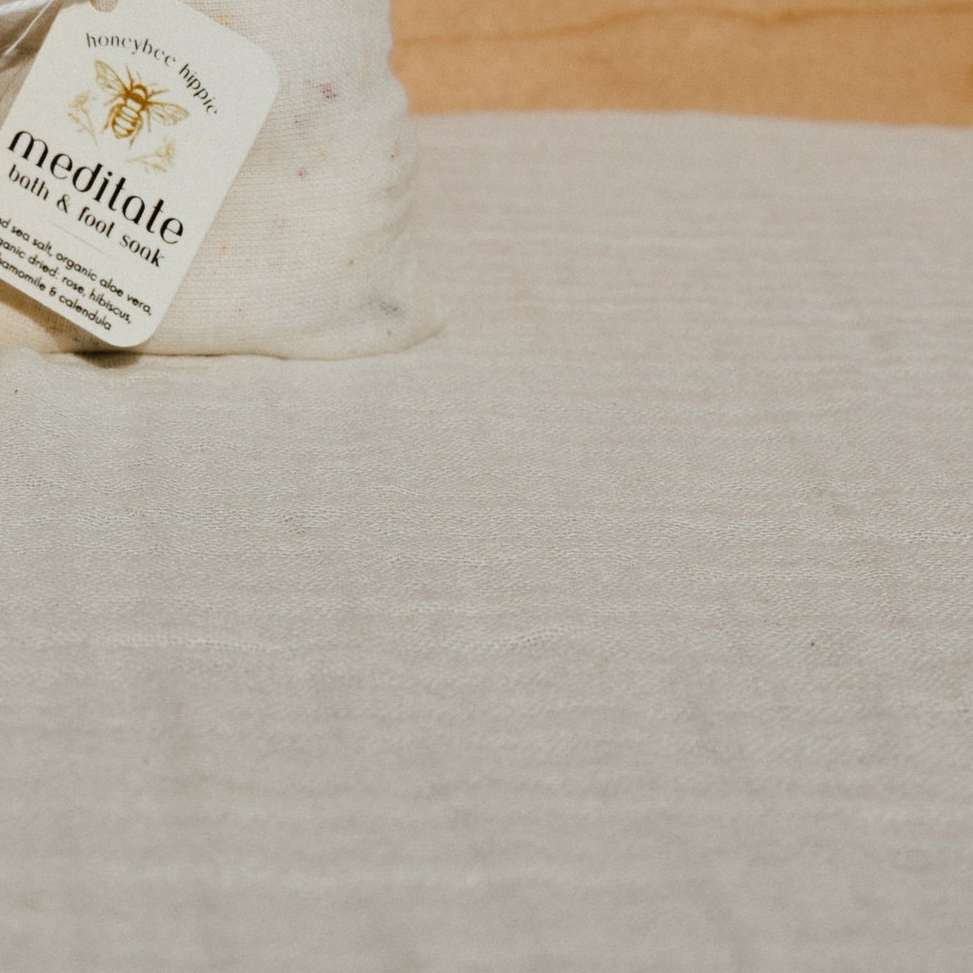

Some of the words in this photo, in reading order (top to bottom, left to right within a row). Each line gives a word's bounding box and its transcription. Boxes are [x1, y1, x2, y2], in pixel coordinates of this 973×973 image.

[86, 32, 176, 67] honeybee
[178, 63, 218, 115] hippie
[8, 130, 184, 245] meditate
[8, 164, 50, 201] bath
[56, 194, 69, 214] &
[77, 206, 116, 238] foot
[119, 234, 166, 268] soak
[11, 226, 30, 242] sea
[32, 236, 54, 257] salt,
[56, 253, 98, 282] organic
[99, 276, 124, 298] aloe
[127, 294, 152, 316] vera,
[28, 253, 60, 278] dried:
[62, 276, 86, 298] rose,
[89, 289, 132, 324] hibiscus,
[49, 286, 57, 297] &
[58, 293, 112, 331] calendula
